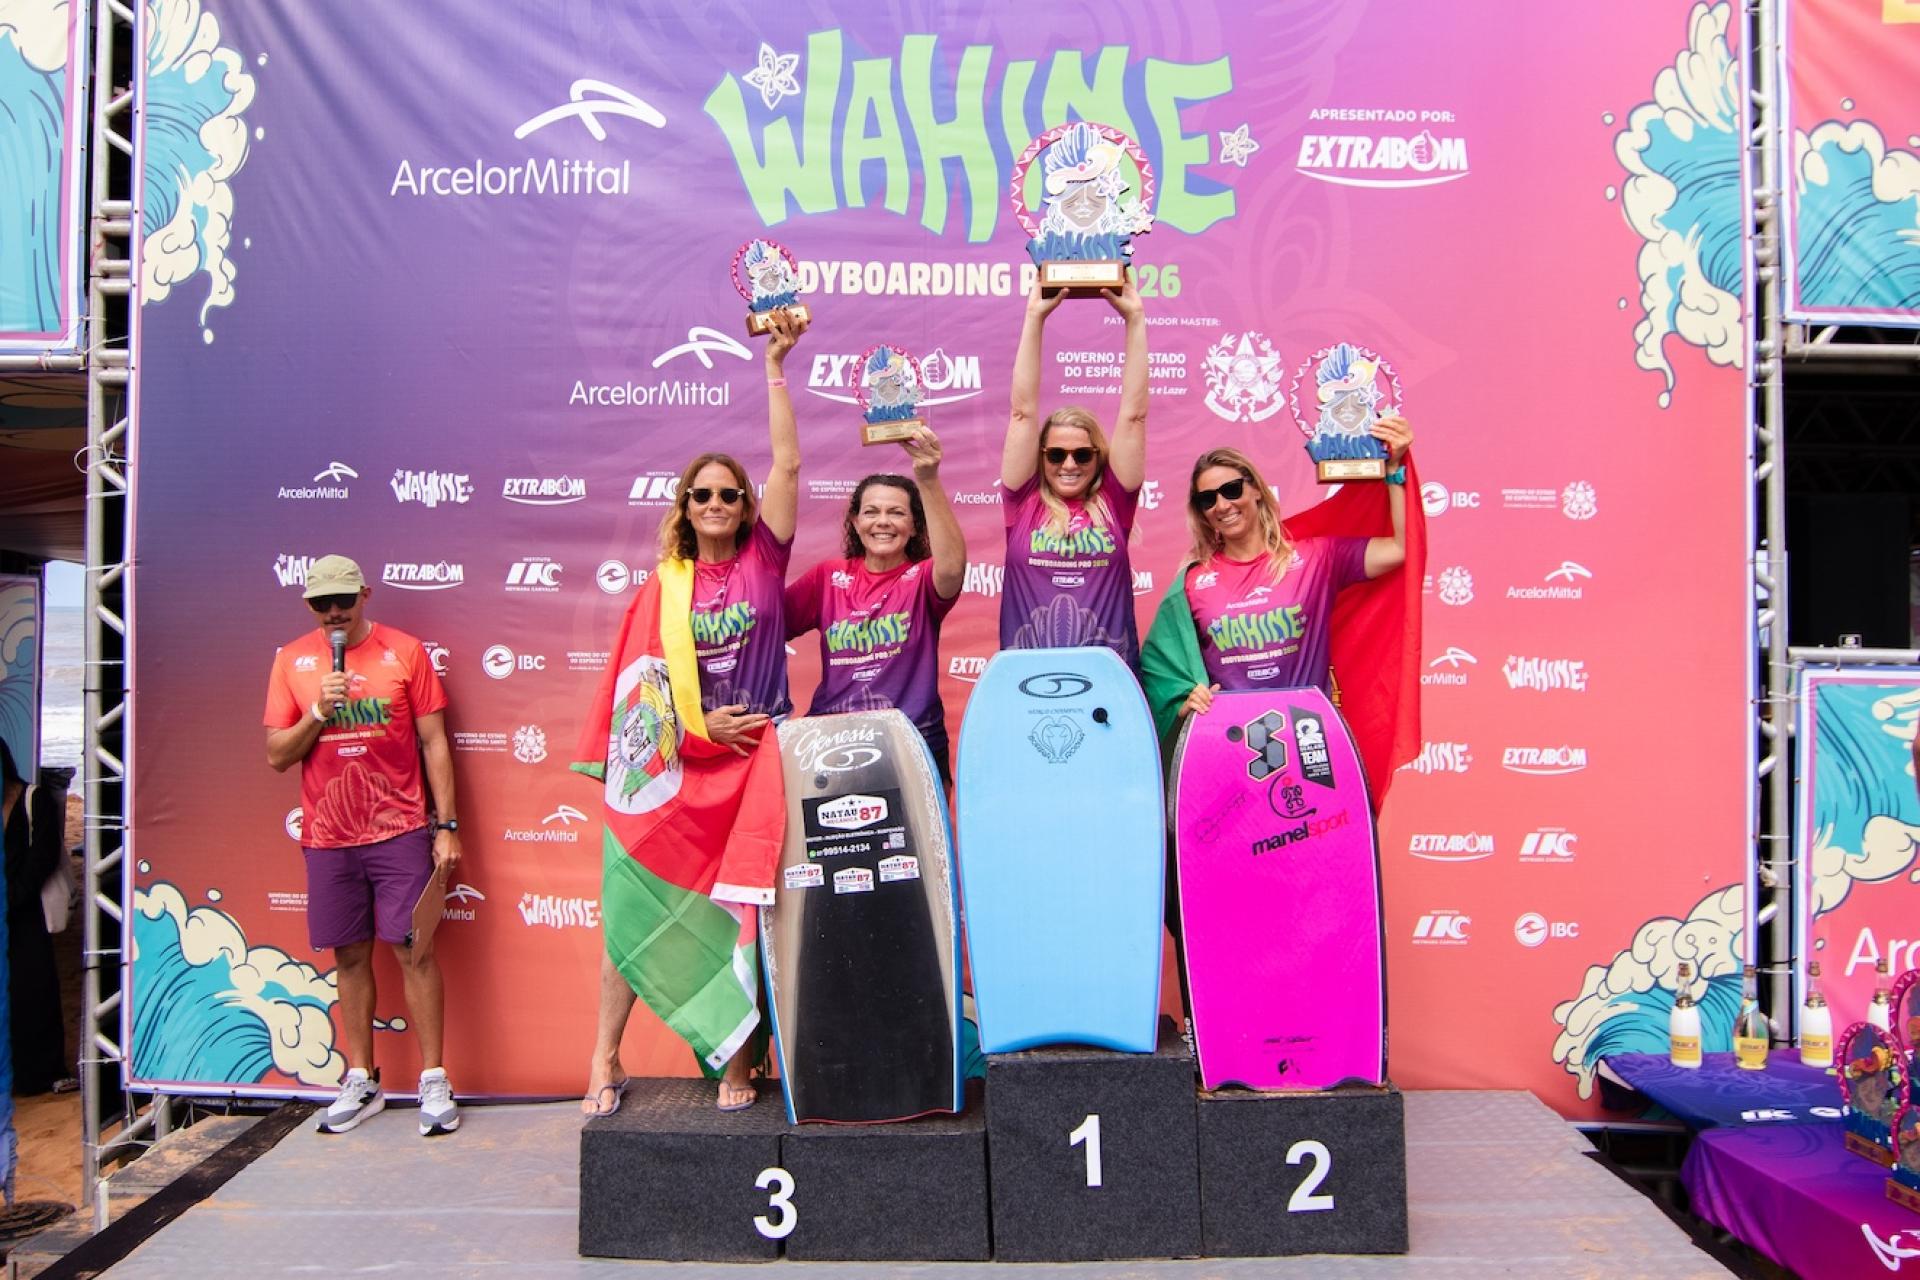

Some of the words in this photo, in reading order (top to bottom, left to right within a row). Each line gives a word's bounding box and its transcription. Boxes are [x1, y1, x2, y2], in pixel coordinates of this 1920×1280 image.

[1309, 109, 1417, 122] APRESENTADO
[1419, 111, 1456, 123] POR:
[703, 28, 1237, 243] WAHINE
[1297, 130, 1469, 171] EXTRABOM
[390, 158, 630, 196] ArcelorMittal
[796, 260, 1011, 297] DYBOARDING
[1180, 317, 1221, 327] MASTER:
[1056, 352, 1115, 364] GOVERNO
[1147, 352, 1186, 364] STADO
[1064, 366, 1082, 378] DO
[1085, 364, 1121, 378] ESPÍR
[569, 379, 729, 406] ArcelorMittal
[1060, 384, 1105, 394] Secretaria
[1106, 384, 1117, 394] de
[1163, 385, 1188, 395] Lazer
[278, 487, 348, 499] ArcelorMittal
[390, 469, 469, 508] WAHINE
[503, 474, 586, 496] EXTRABOM
[1451, 491, 1480, 507] IBC
[273, 555, 316, 587] WAH
[382, 560, 463, 583] EXTRABOM
[1506, 586, 1582, 599] ArcelorMittal
[1207, 604, 1303, 652] WAHINE
[518, 655, 545, 670] IBC
[1502, 656, 1586, 692] WAHINE
[794, 725, 883, 771] Genesis
[1301, 749, 1328, 765] TEAM
[1503, 745, 1587, 765] EXTRABOM
[821, 809, 857, 819] NATAU
[859, 806, 882, 821] 87
[504, 829, 578, 843] ArcelorMittal
[1252, 811, 1350, 855] manelsport
[1409, 831, 1494, 852] EXTRABOM
[902, 861, 914, 870] 87
[518, 893, 599, 929] WAHINE
[1550, 922, 1579, 937] IBC
[1068, 1114, 1103, 1187] 1
[1286, 1141, 1336, 1213] 2
[753, 1168, 798, 1240] 3
